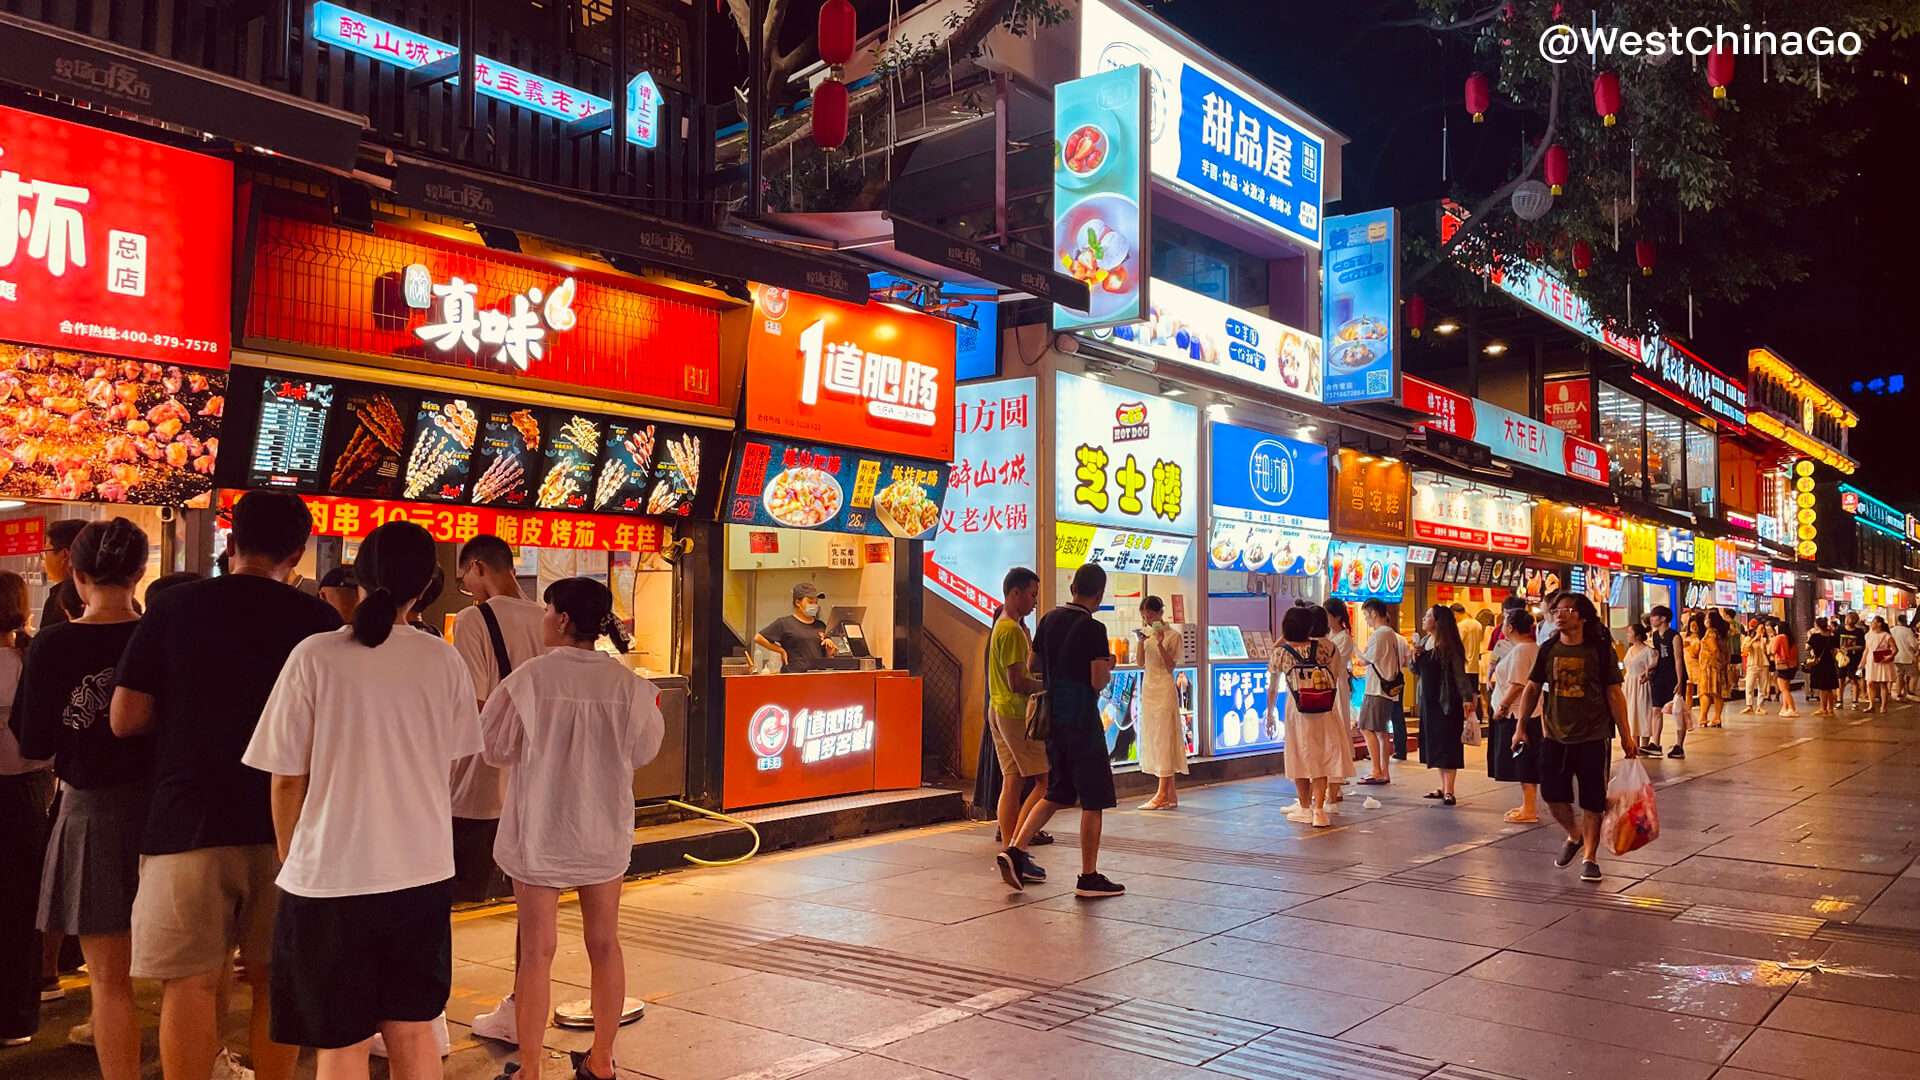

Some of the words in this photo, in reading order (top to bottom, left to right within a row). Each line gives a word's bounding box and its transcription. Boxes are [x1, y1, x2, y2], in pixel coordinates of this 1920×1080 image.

[1202, 91, 1293, 187] 甜品屋
[115, 238, 139, 291] 总店
[415, 276, 545, 371] 真味
[799, 319, 939, 411] 1道肥肠
[1113, 428, 1131, 440] HOT
[1131, 426, 1149, 439] DOG
[1504, 415, 1548, 457] 大东匠人
[1075, 443, 1182, 522] 芝士棒
[938, 503, 1028, 535] 义老火锅
